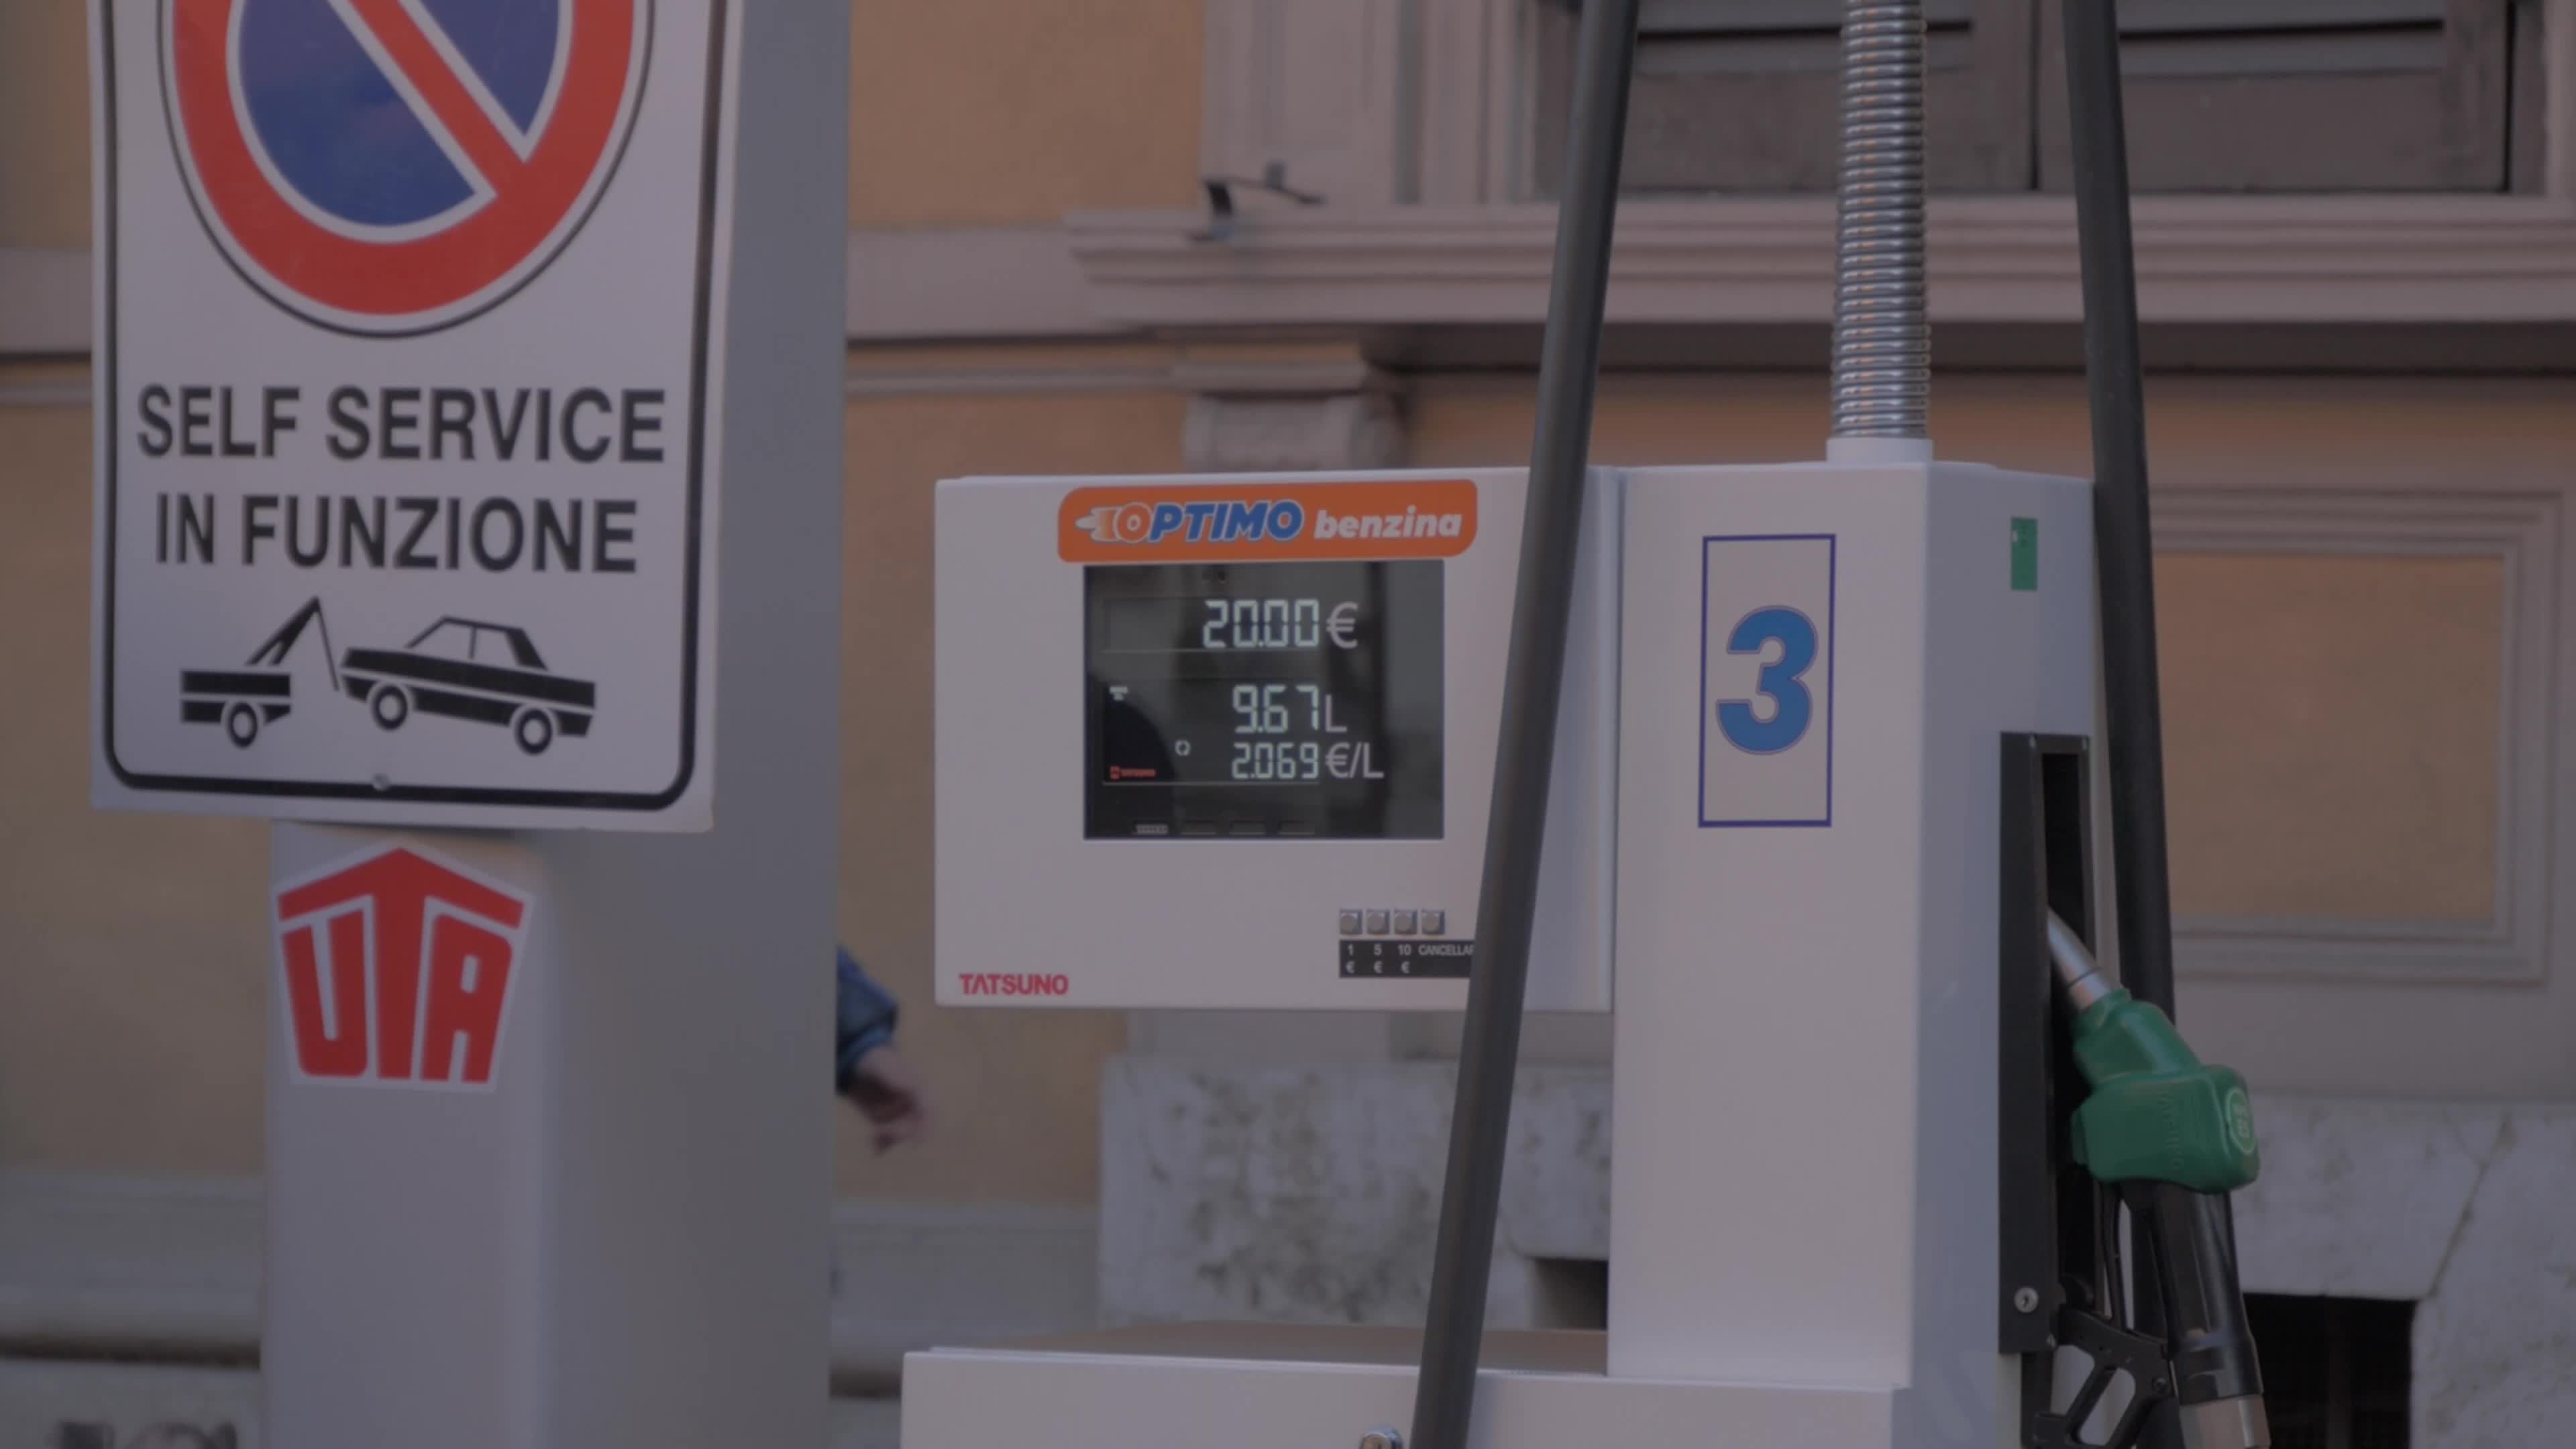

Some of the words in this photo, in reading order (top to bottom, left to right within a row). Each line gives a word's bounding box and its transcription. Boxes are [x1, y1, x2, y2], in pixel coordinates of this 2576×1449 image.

[137, 384, 300, 458] SELF
[325, 387, 665, 463] SERVICE
[156, 493, 215, 565] IN
[241, 495, 637, 574] FUNZIONE
[1112, 500, 1304, 544] OPTIMO
[1313, 505, 1462, 539] benzina
[1715, 605, 1819, 755] 3
[1347, 944, 1354, 956] 1
[1374, 944, 1382, 956] 5
[1398, 944, 1411, 956] 10
[959, 973, 1069, 996] TATSUNO
